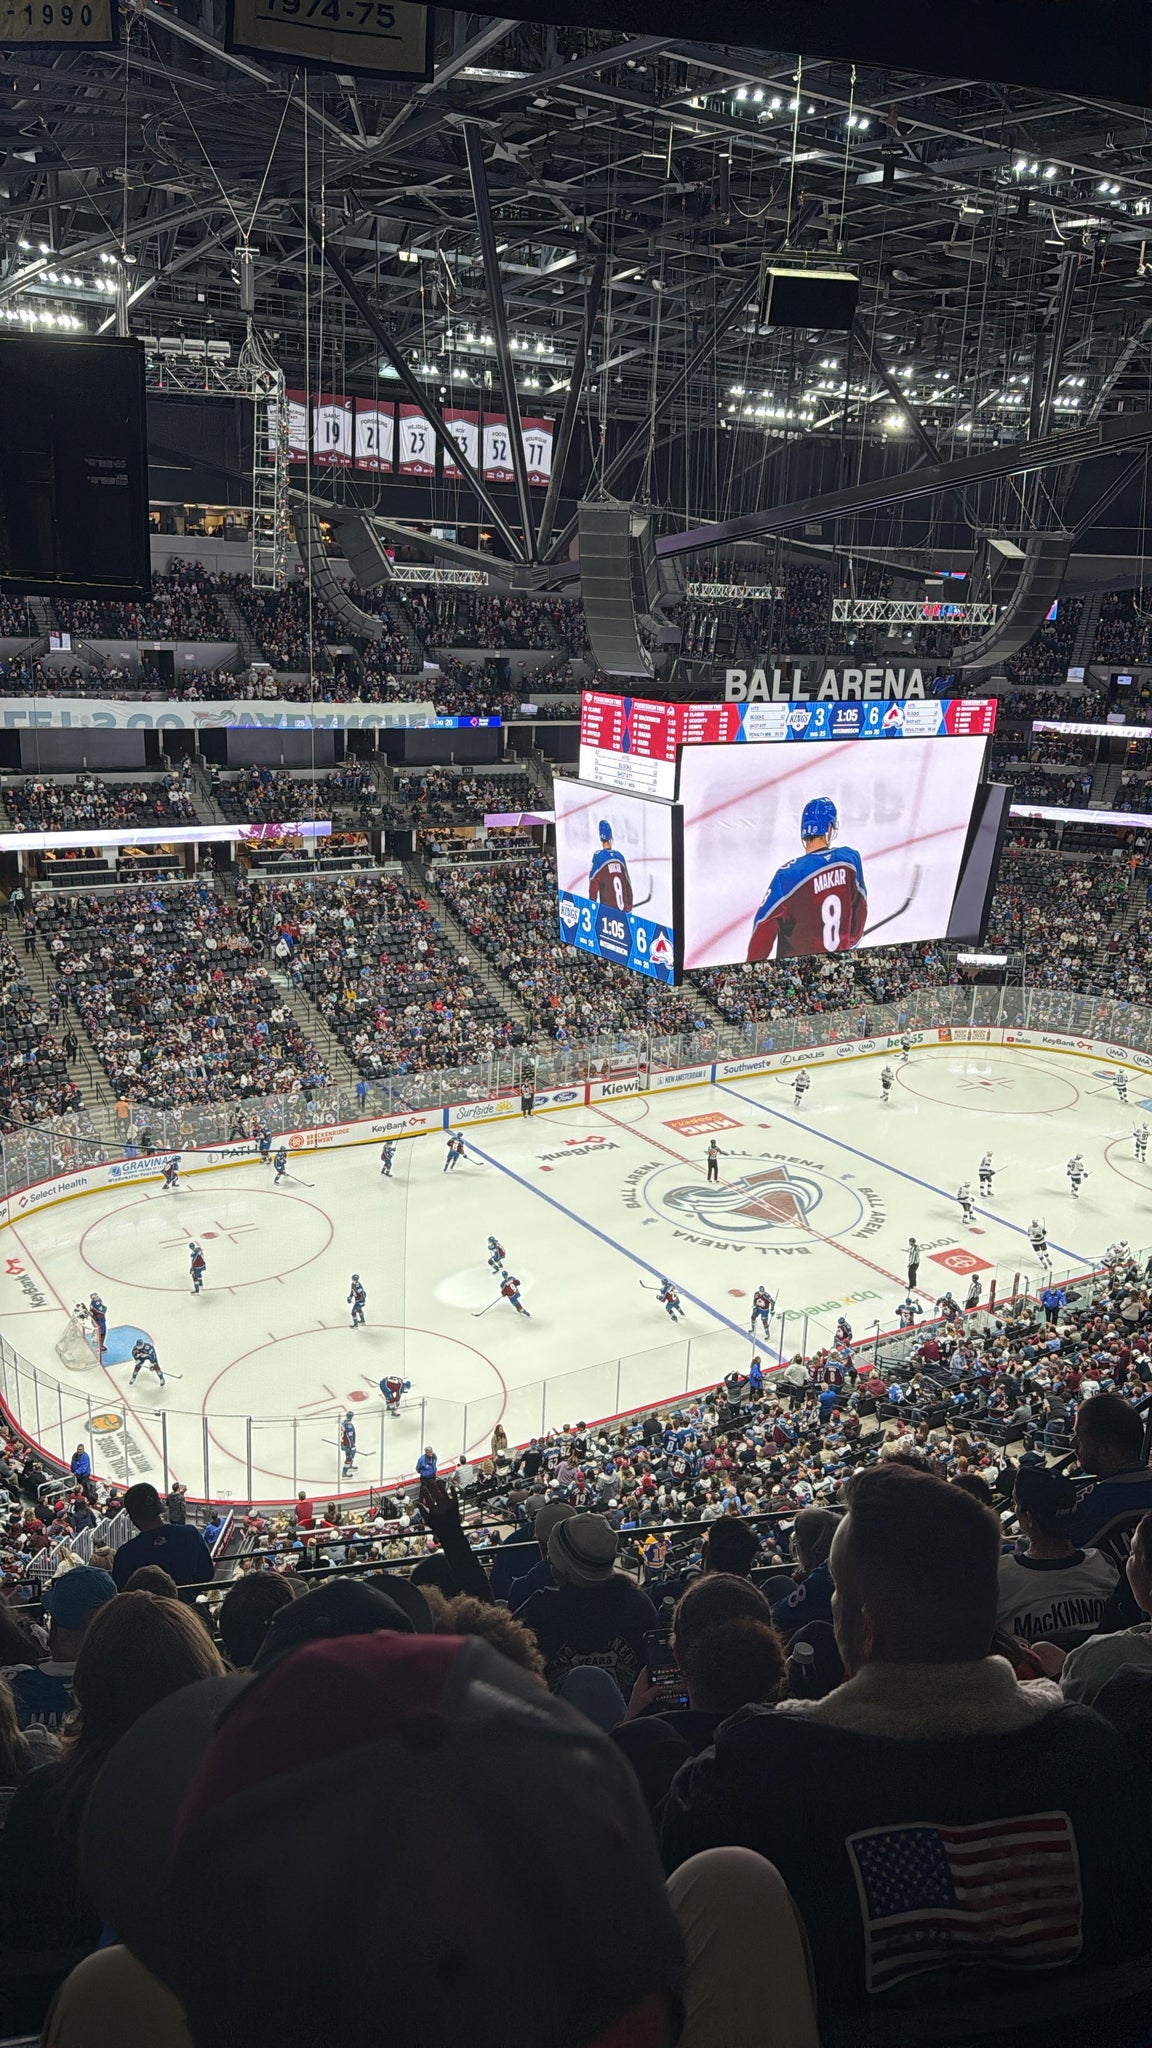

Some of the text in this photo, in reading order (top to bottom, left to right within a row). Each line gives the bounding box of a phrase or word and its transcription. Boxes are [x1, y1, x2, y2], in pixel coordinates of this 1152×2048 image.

[325, 420, 340, 444] 19
[410, 431, 425, 454] 23
[492, 438, 507, 461] 52
[529, 443, 543, 465] 77
[724, 668, 926, 702] BALL ARENA
[814, 708, 825, 727] 3
[836, 709, 858, 722] 1:05
[870, 706, 879, 724] 6
[813, 868, 846, 894] MAKAR
[613, 876, 625, 911] 8
[560, 907, 578, 920] KINGS
[581, 908, 592, 932] 3
[821, 894, 842, 952] 8
[602, 917, 625, 940] 1:05
[636, 928, 648, 954] 6
[1042, 1036, 1076, 1048] KeyBank
[792, 1051, 825, 1062] LEXUS
[724, 1060, 766, 1074] Southwest
[664, 1075, 675, 1084] NEW
[456, 1103, 494, 1120] Surfside
[306, 1128, 350, 1140] BRECKENRIDGE
[372, 1121, 408, 1133] KeyBank
[679, 1118, 737, 1137] KING
[536, 1142, 620, 1162] KeyBank
[759, 1152, 826, 1171] ARENA
[30, 1178, 88, 1202] Select Health
[622, 1160, 665, 1210] BALL ARENA
[852, 1187, 888, 1240] BALL ARENA
[672, 1229, 812, 1256] BALL ARENA
[14, 1274, 48, 1308] KeyBank
[842, 1290, 883, 1306] bpx
[666, 1442, 674, 1452] 8
[673, 1462, 686, 1474] 88
[576, 1494, 586, 1506] 19
